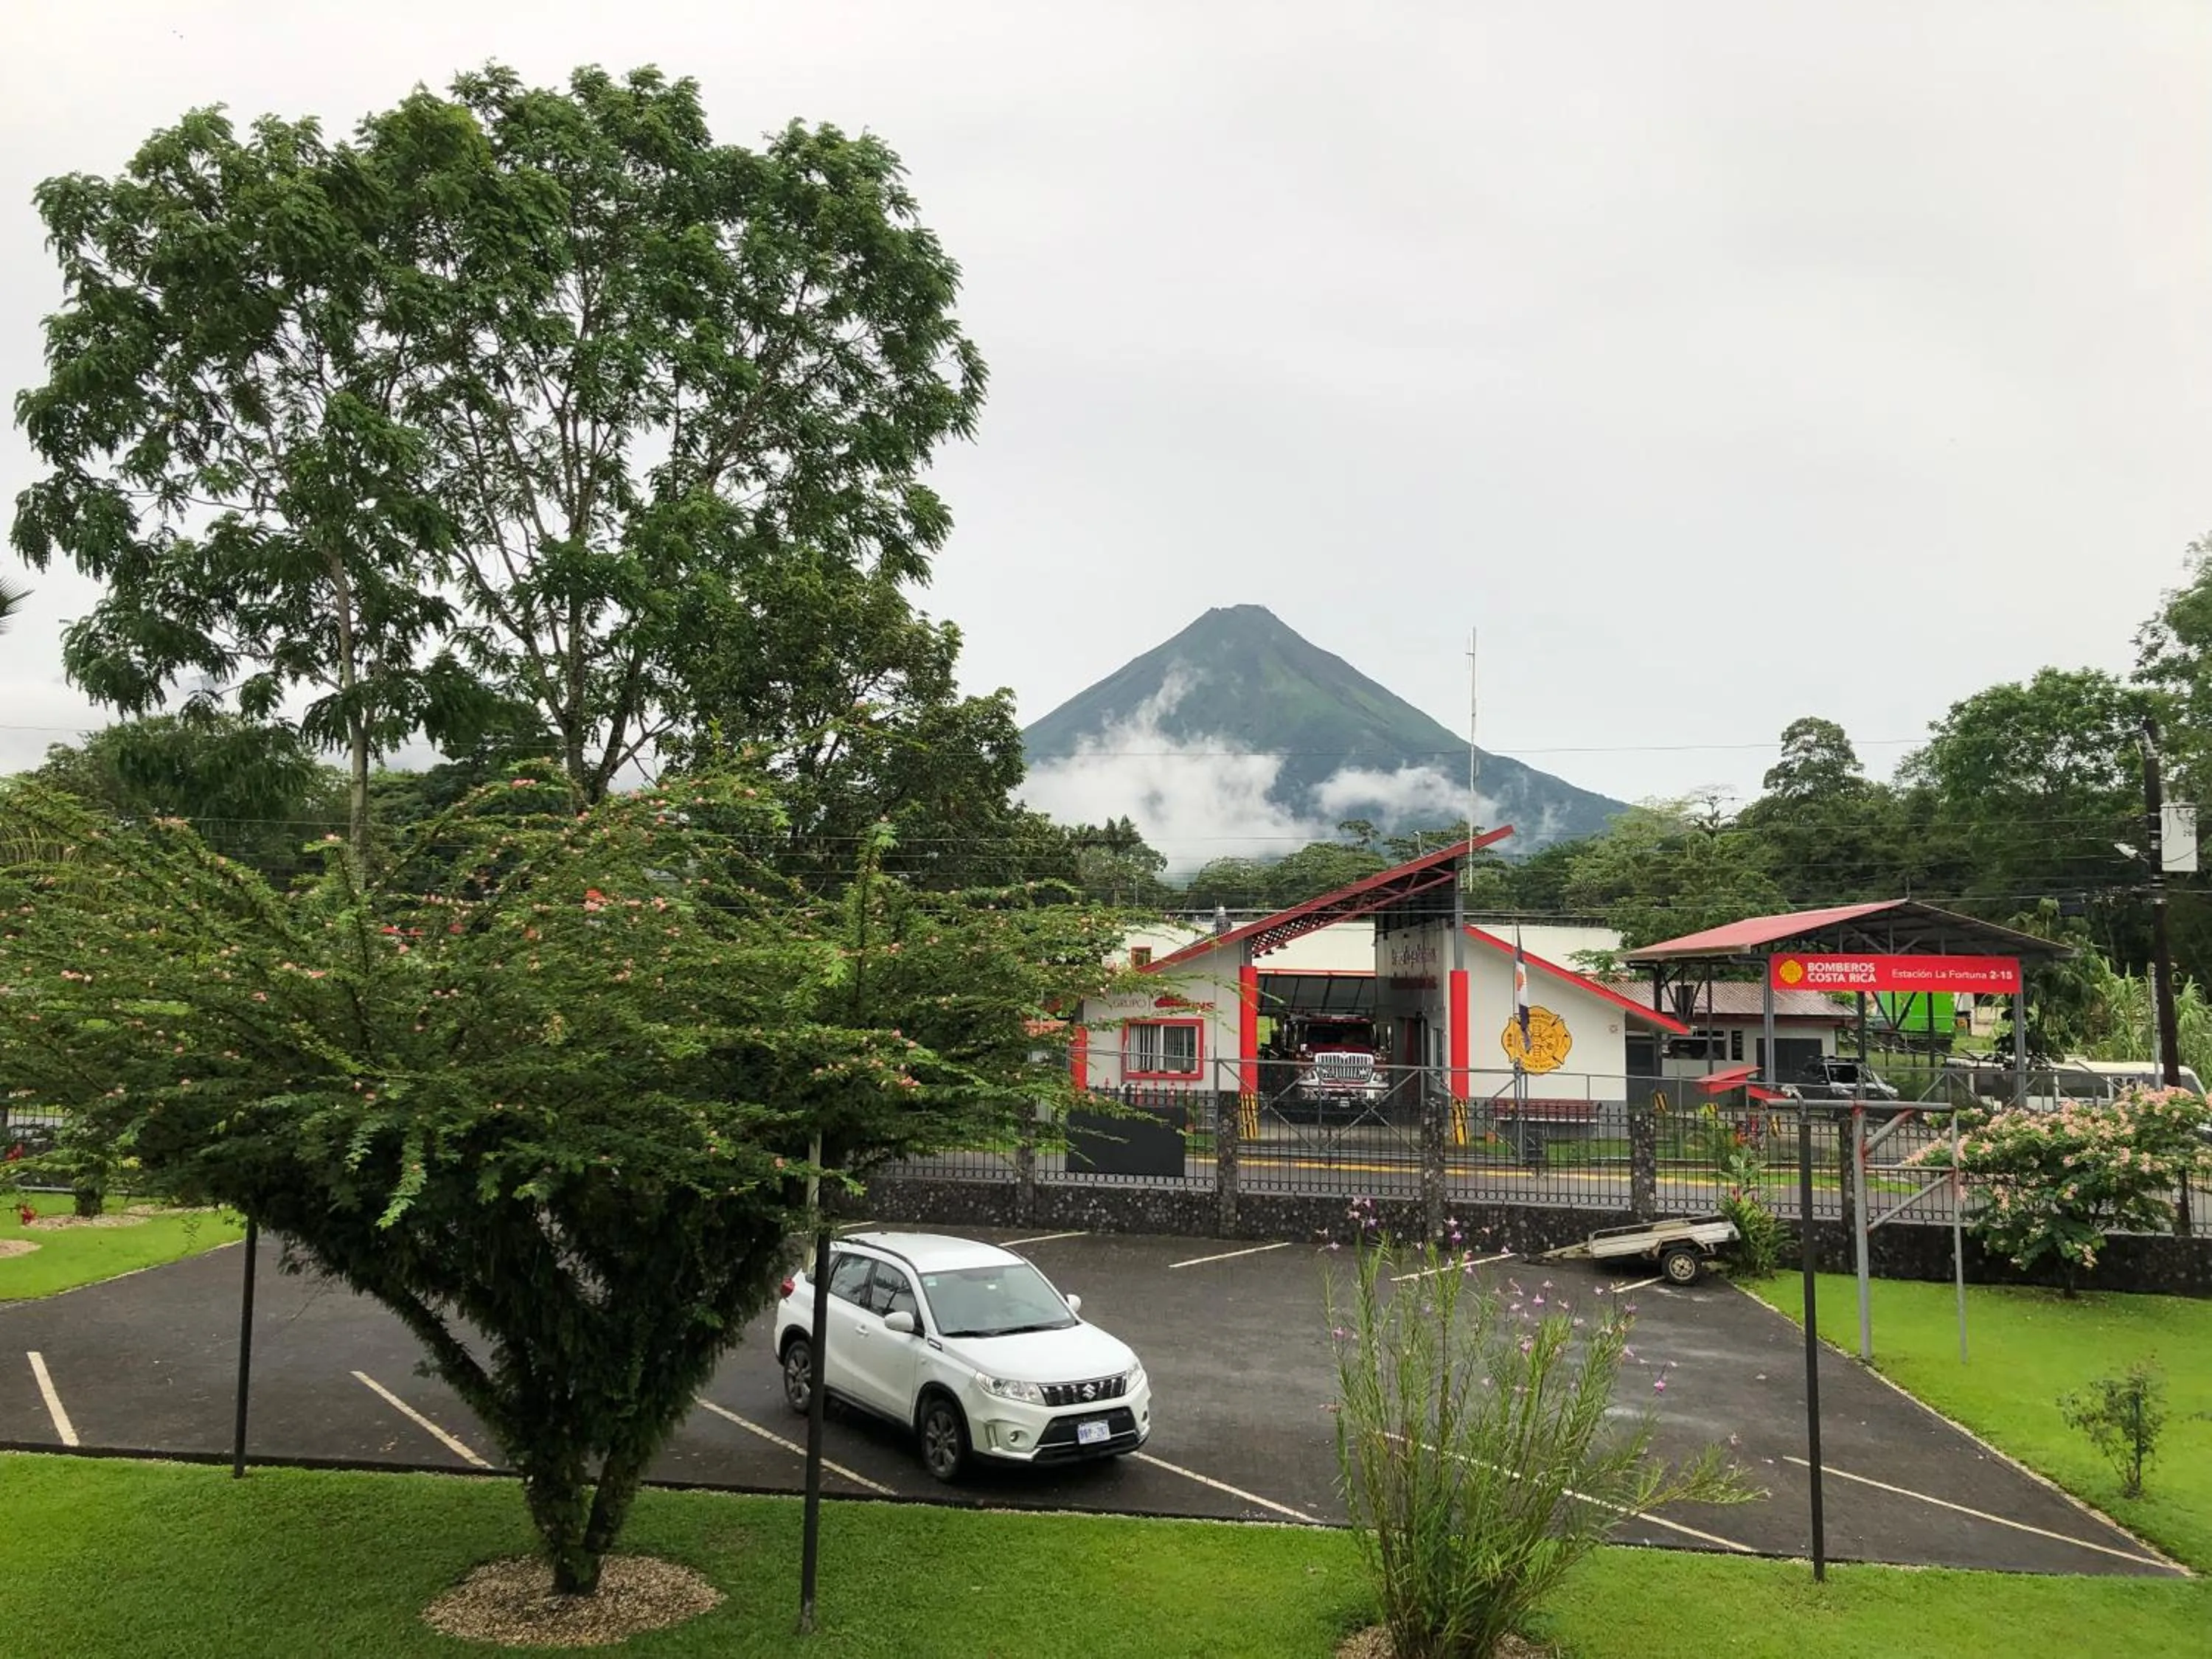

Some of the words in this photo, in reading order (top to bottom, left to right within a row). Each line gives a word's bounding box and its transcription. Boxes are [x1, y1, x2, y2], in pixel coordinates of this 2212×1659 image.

[1807, 962, 1876, 973] BOMBEROS
[1891, 967, 1933, 978] Estación
[1935, 969, 1947, 978] La
[1949, 970, 1987, 979] Fortuna
[1807, 973, 1846, 983] COSTA
[1848, 973, 1877, 983] RICA
[1113, 998, 1147, 1009] GRUPO
